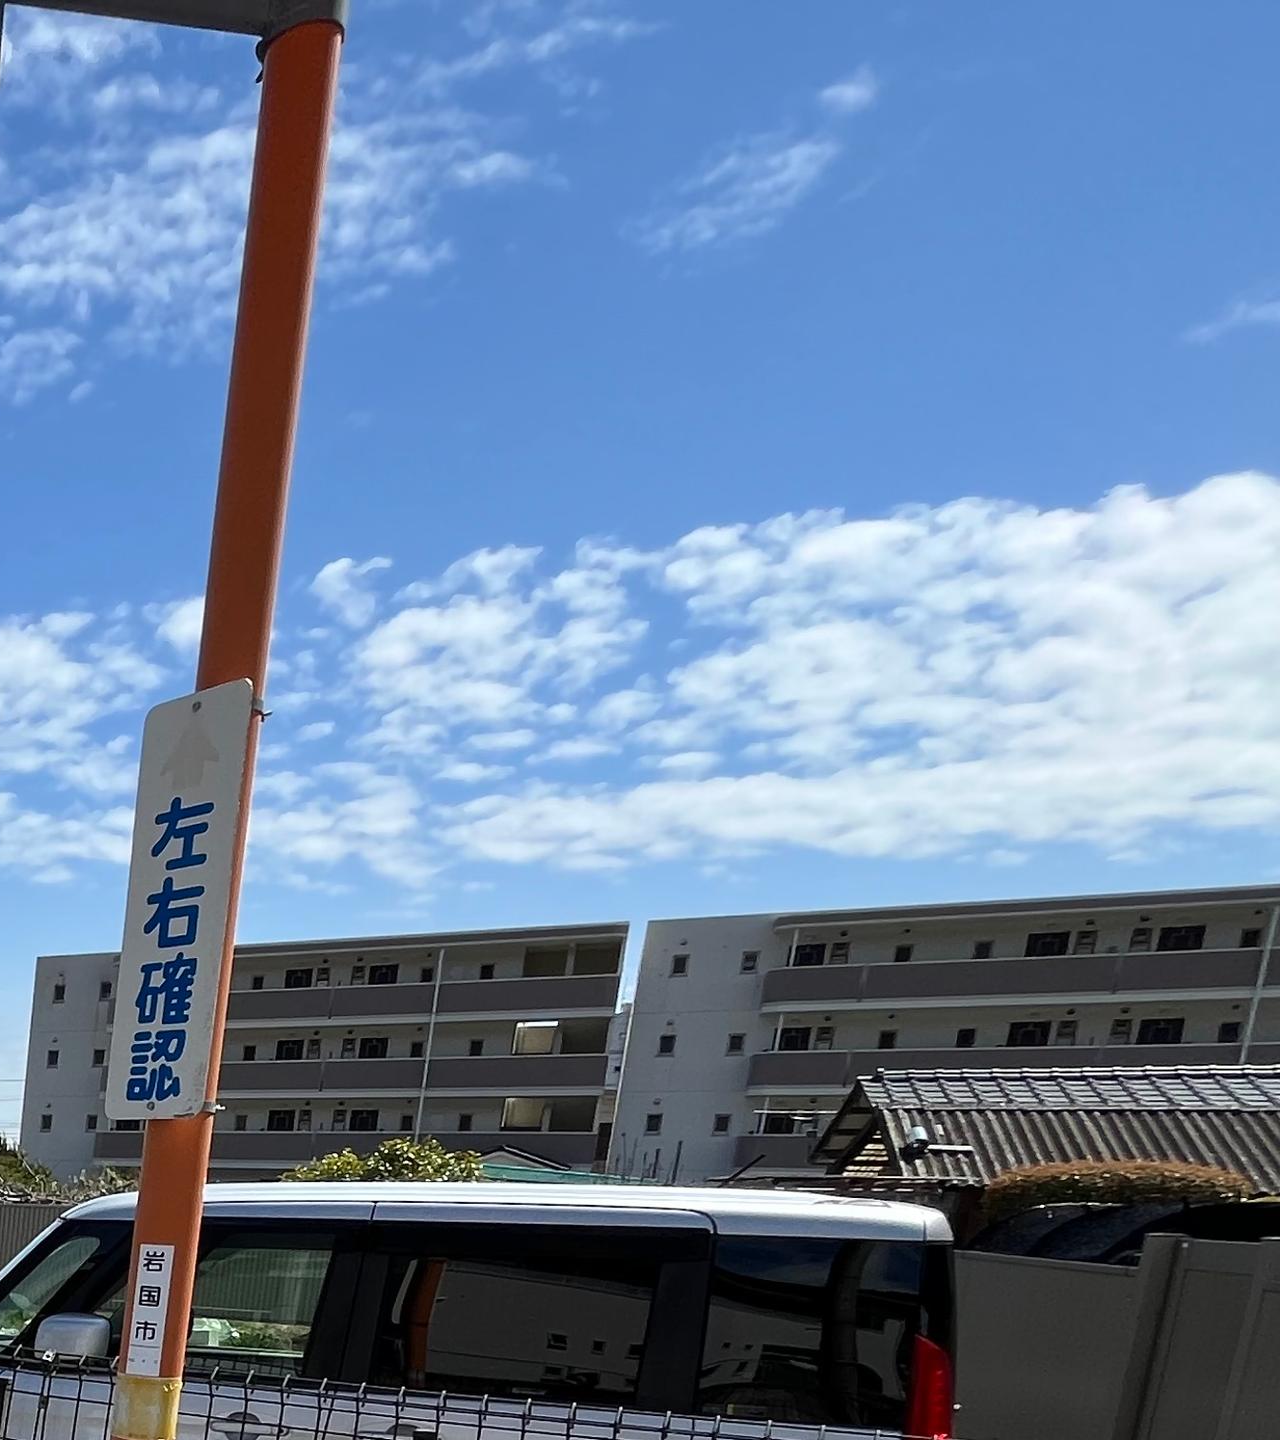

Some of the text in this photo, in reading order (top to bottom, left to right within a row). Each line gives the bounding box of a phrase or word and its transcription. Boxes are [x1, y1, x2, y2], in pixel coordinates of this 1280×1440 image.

[126, 796, 215, 1102] 左右確認
[134, 1249, 166, 1341] 岩国市
